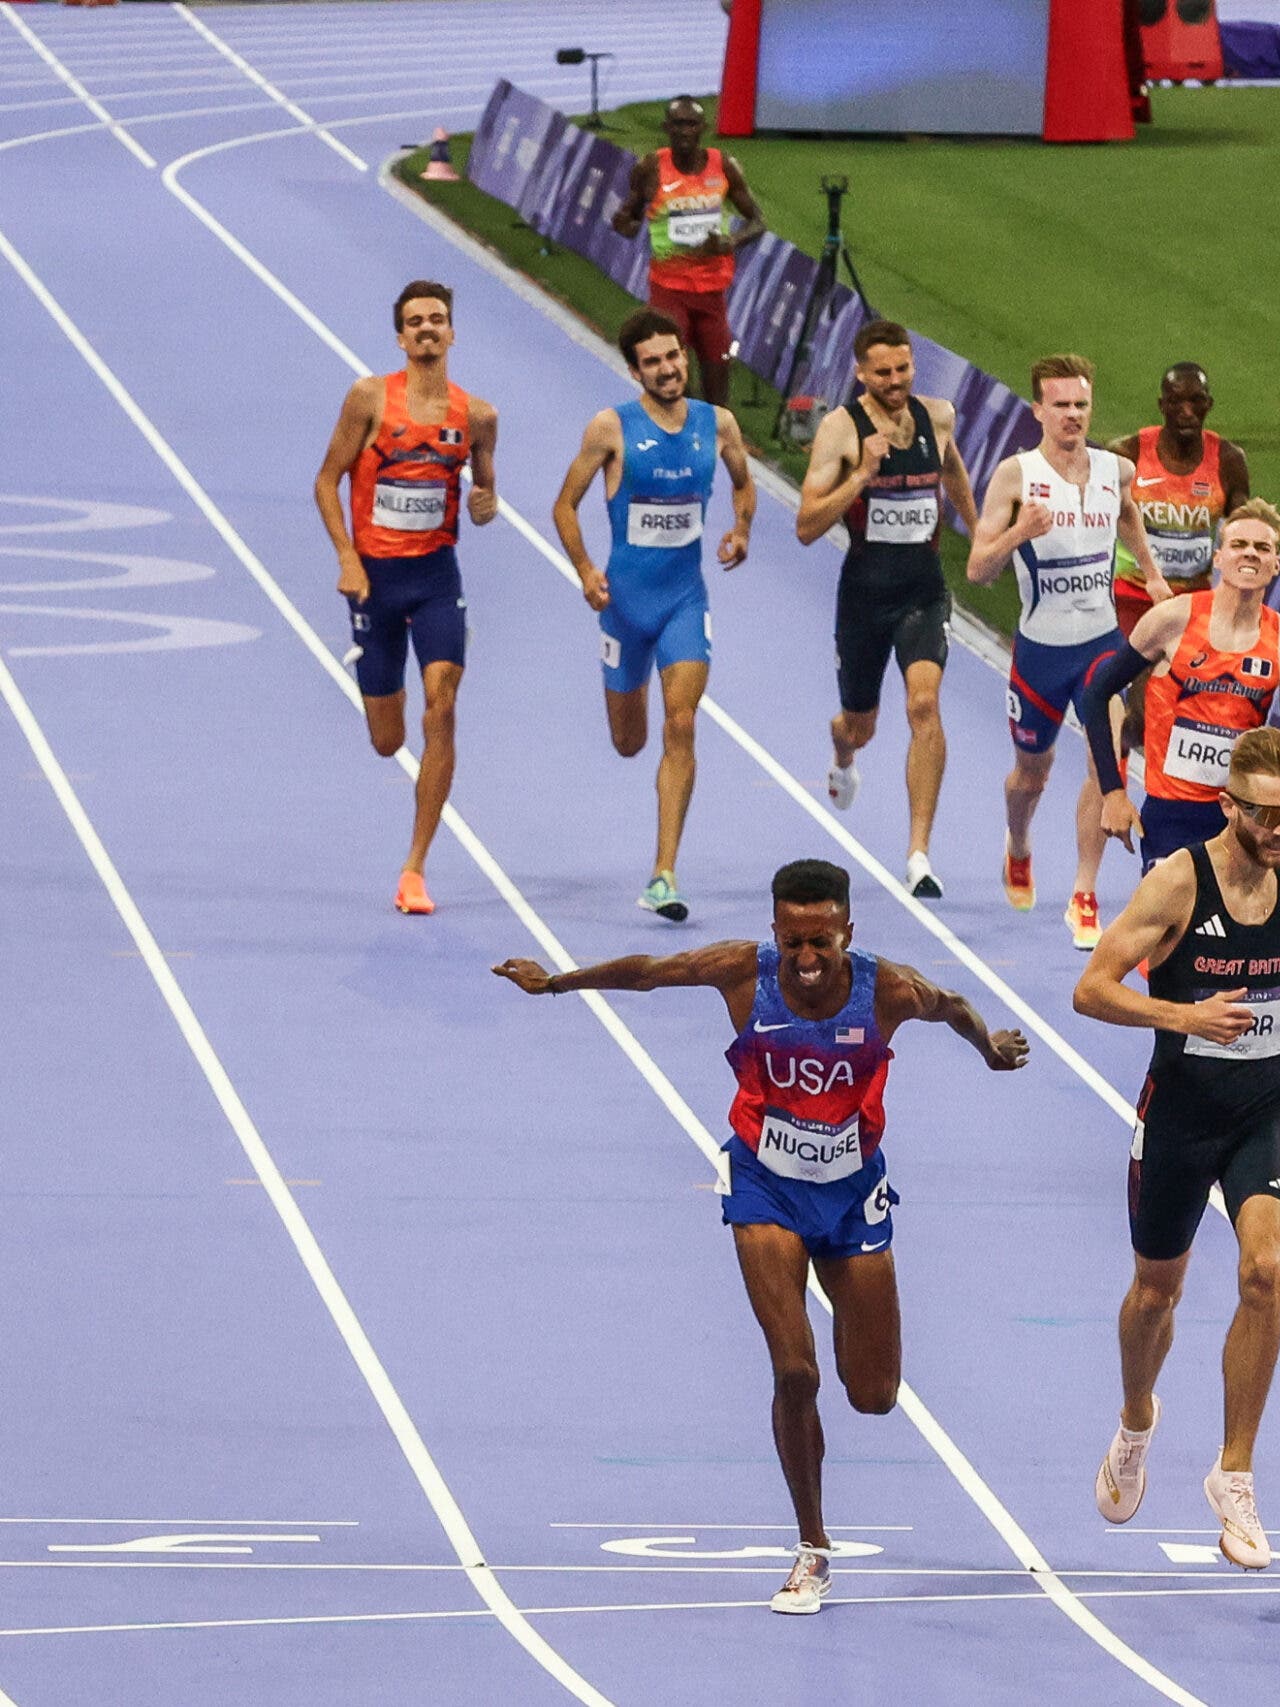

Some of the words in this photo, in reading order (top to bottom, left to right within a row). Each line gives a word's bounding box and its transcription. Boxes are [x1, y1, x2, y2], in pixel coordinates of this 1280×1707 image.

[640, 513, 691, 530] ARESE
[871, 508, 935, 526] GOURLE
[1139, 501, 1210, 528] KENYA
[1041, 571, 1112, 594] NORDAS
[1194, 955, 1245, 976] GREAT
[766, 1052, 854, 1095] USA
[766, 1128, 857, 1164] NUGUSE
